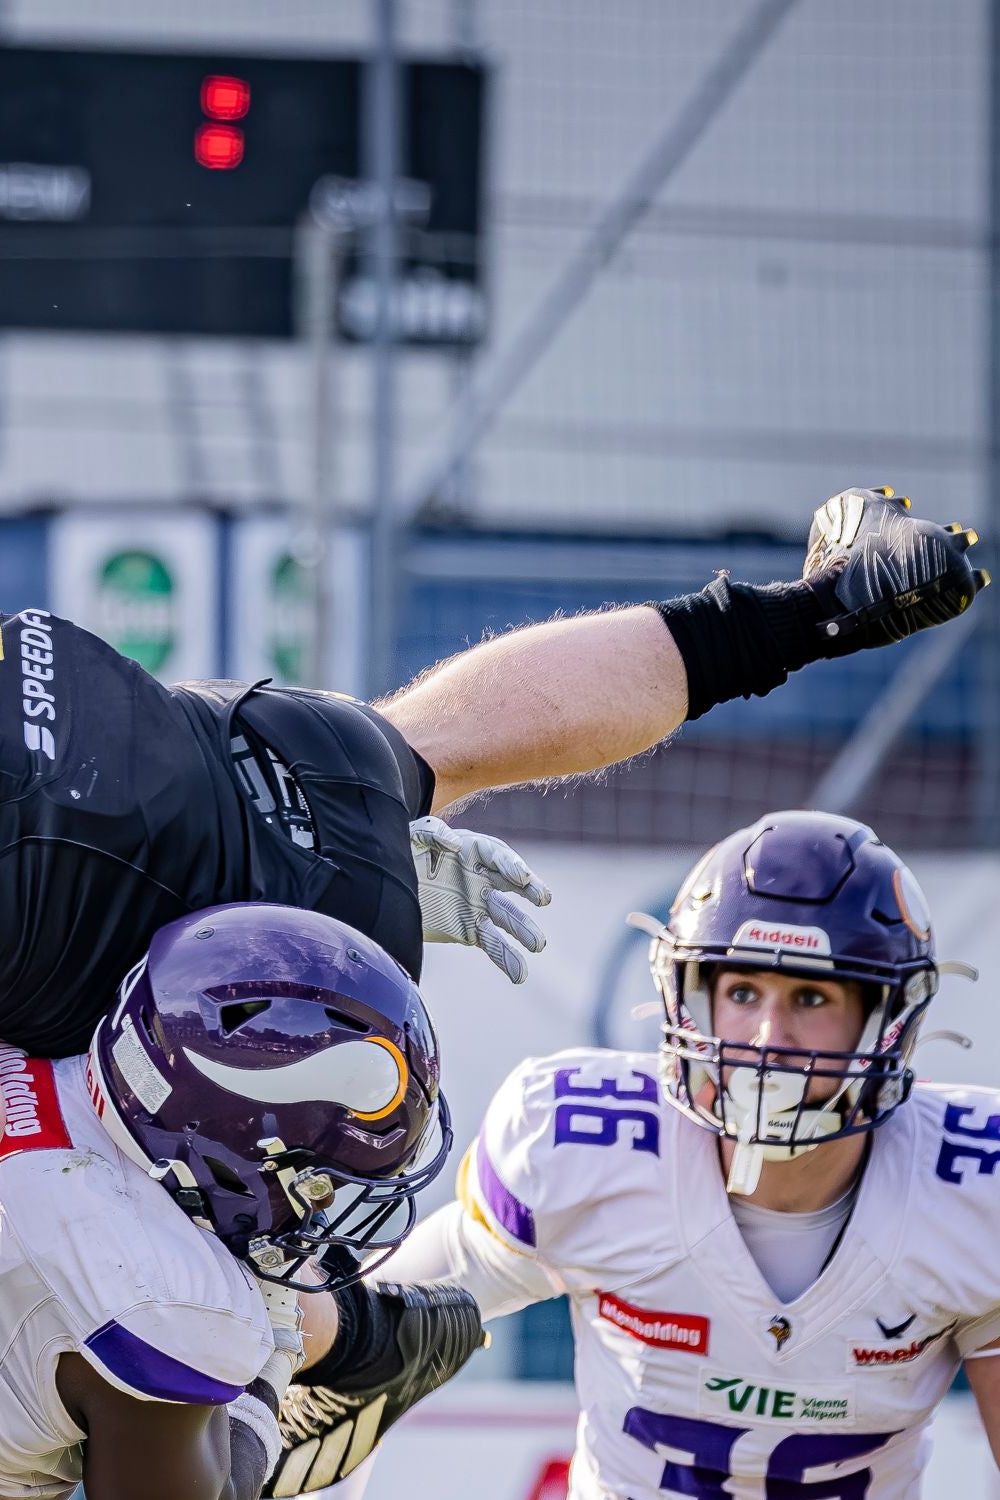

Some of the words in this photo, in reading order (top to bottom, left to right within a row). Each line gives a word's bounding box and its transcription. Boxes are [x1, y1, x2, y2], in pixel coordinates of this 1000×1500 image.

[749, 927, 819, 948] Riddell
[553, 1067, 660, 1158] 36
[727, 1384, 797, 1418] VIE
[802, 1398, 848, 1408] Vienna
[800, 1408, 848, 1420] Airport
